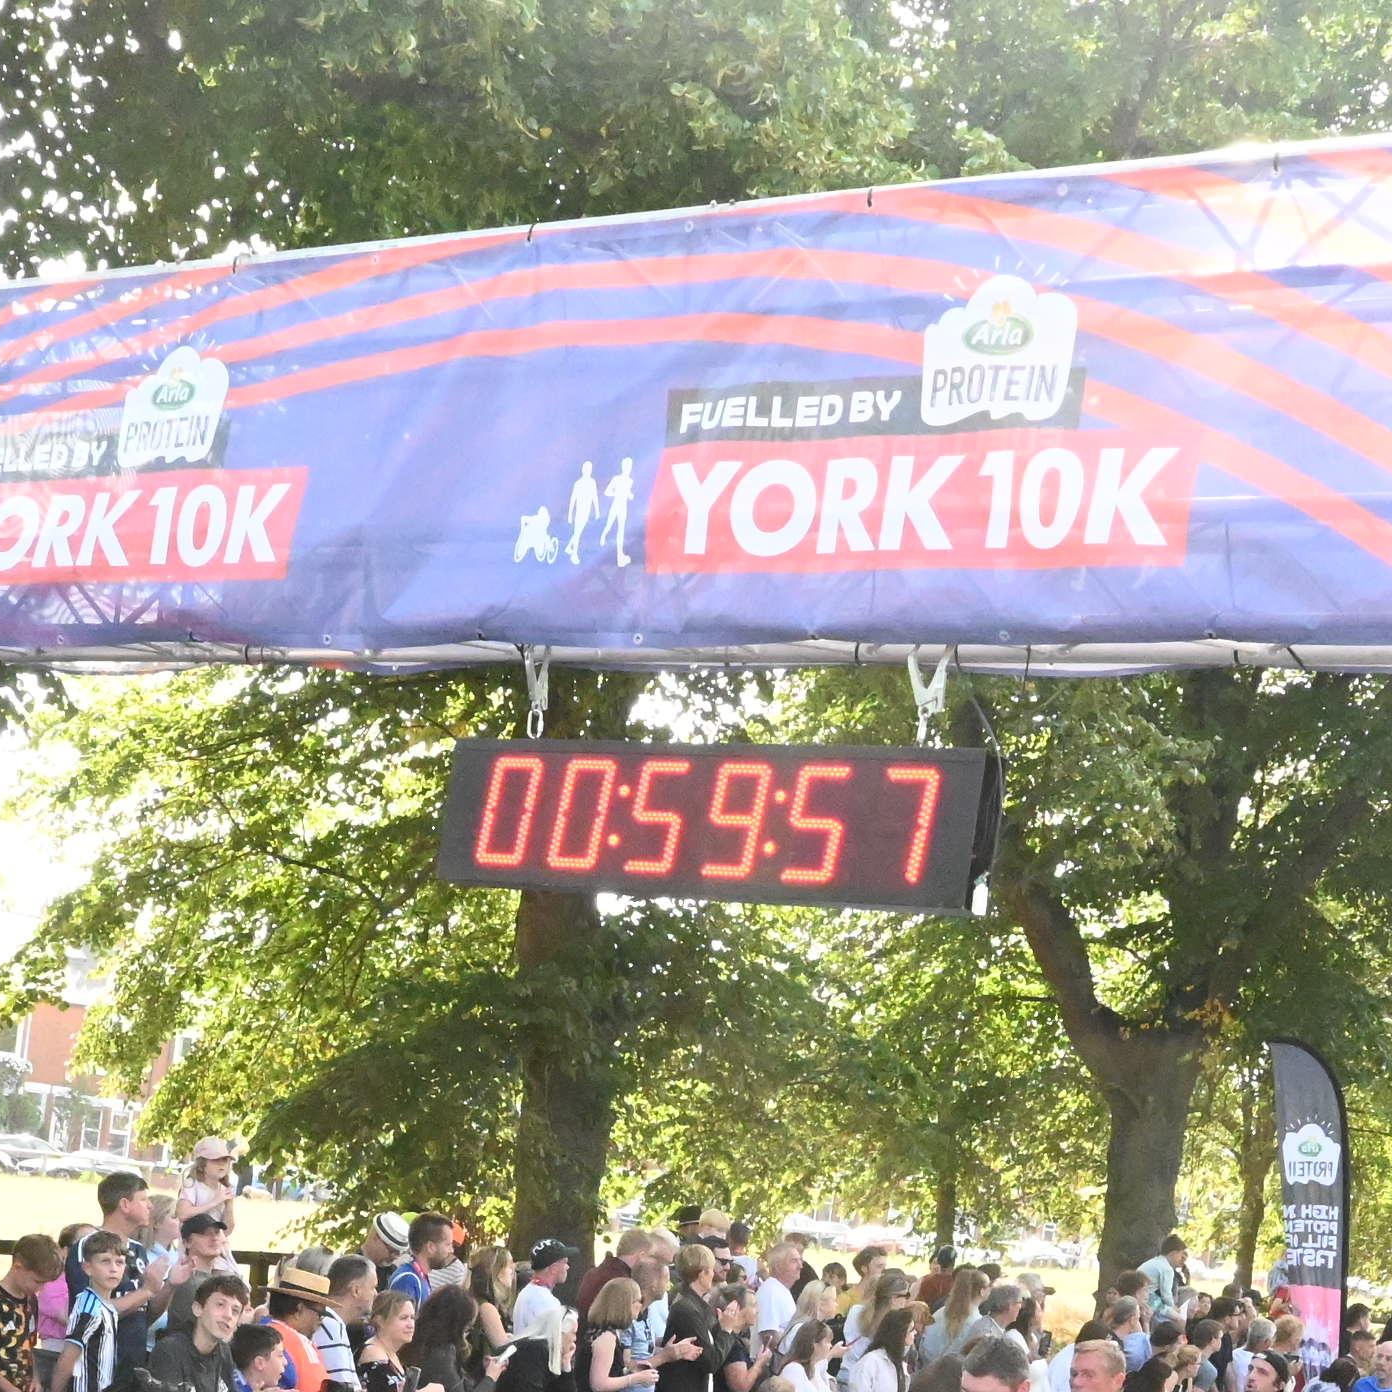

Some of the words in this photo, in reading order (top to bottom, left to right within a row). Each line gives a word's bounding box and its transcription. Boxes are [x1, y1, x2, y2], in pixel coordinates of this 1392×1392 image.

[969, 321, 1025, 349] Arla
[152, 380, 192, 408] Arla
[928, 362, 1060, 408] PROTEIN
[679, 393, 843, 434] FUELLED
[849, 389, 902, 422] BY
[73, 441, 108, 466] BY
[125, 413, 209, 456] PROTEIN
[670, 454, 966, 558] YORK
[978, 446, 1181, 550] 10K
[149, 483, 292, 567] 10K
